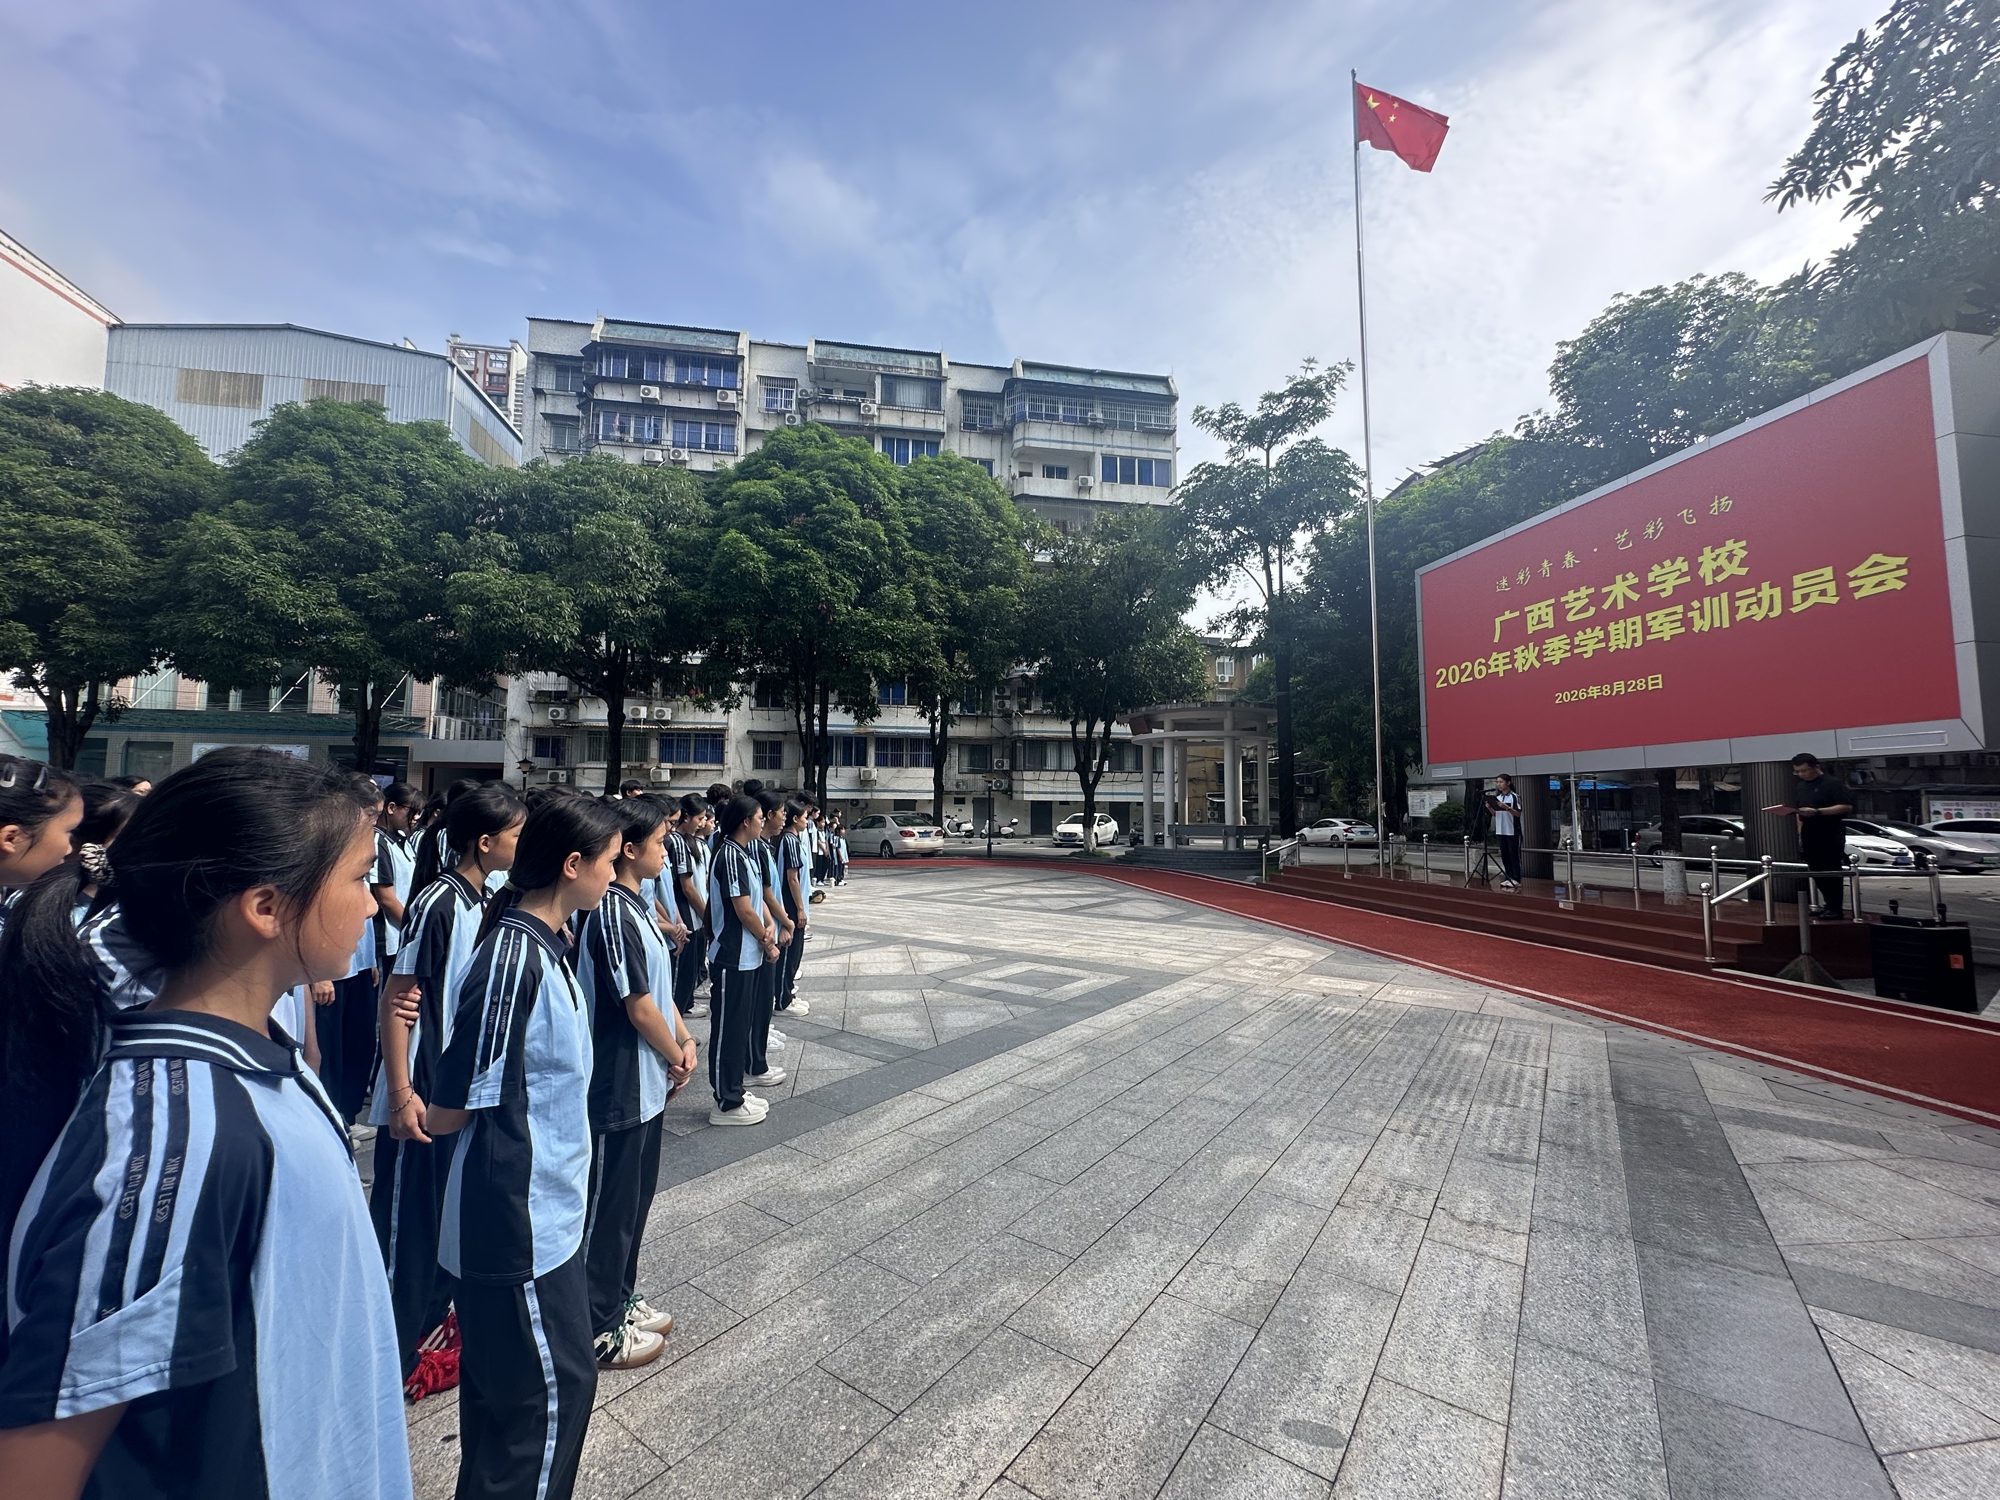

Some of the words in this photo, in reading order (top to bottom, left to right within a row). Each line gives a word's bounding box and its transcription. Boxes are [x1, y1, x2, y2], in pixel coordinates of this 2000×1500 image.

[1435, 552, 1909, 689] 2026年秋季学期军训动员会
[1493, 539, 1749, 643] 广西艺术学校
[1555, 673, 1663, 704] 2026年8月28日
